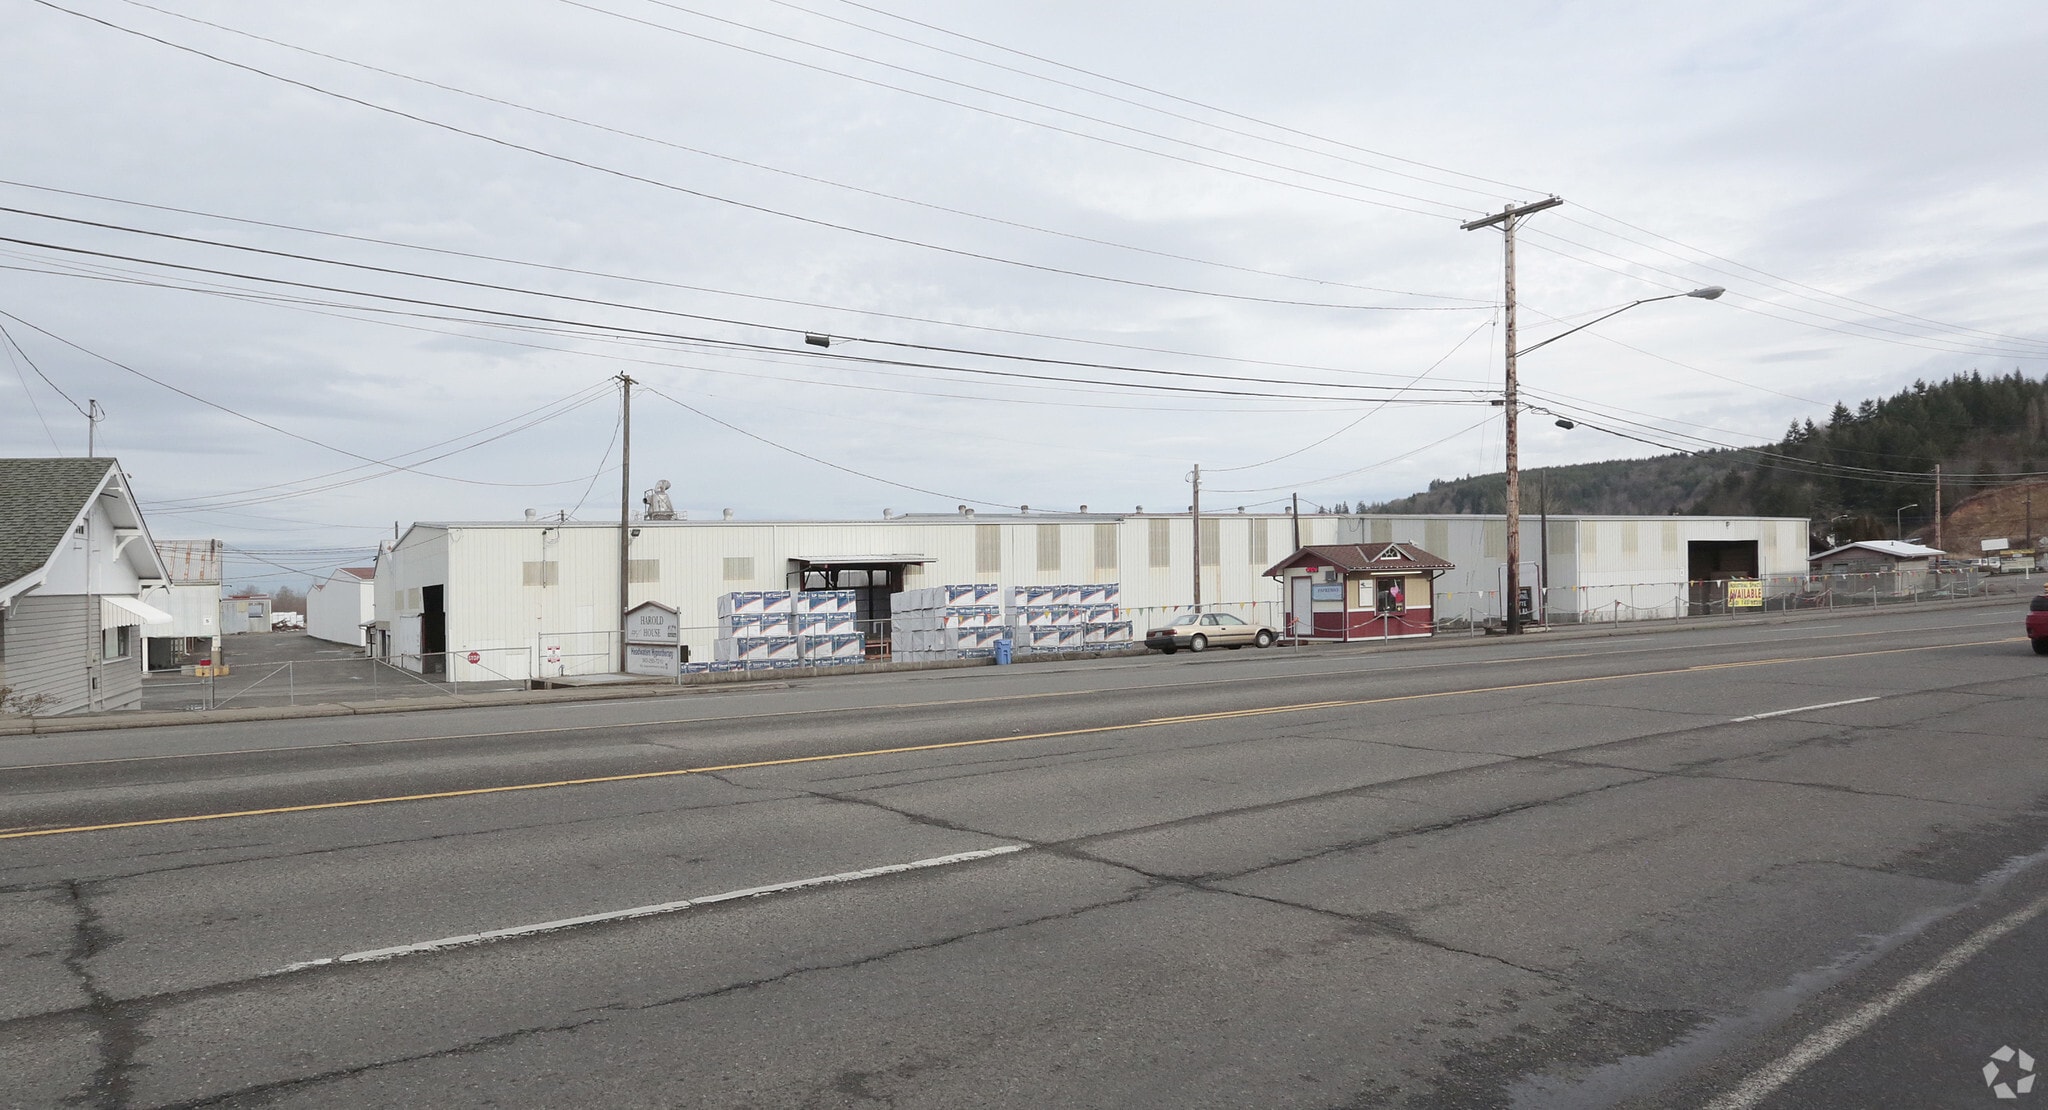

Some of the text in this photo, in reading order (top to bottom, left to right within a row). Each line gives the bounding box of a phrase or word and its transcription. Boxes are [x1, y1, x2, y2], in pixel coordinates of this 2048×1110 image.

[1730, 588, 1761, 599] AVAILABLE
[640, 615, 664, 625] HAROLD
[643, 629, 661, 637] HOUSE
